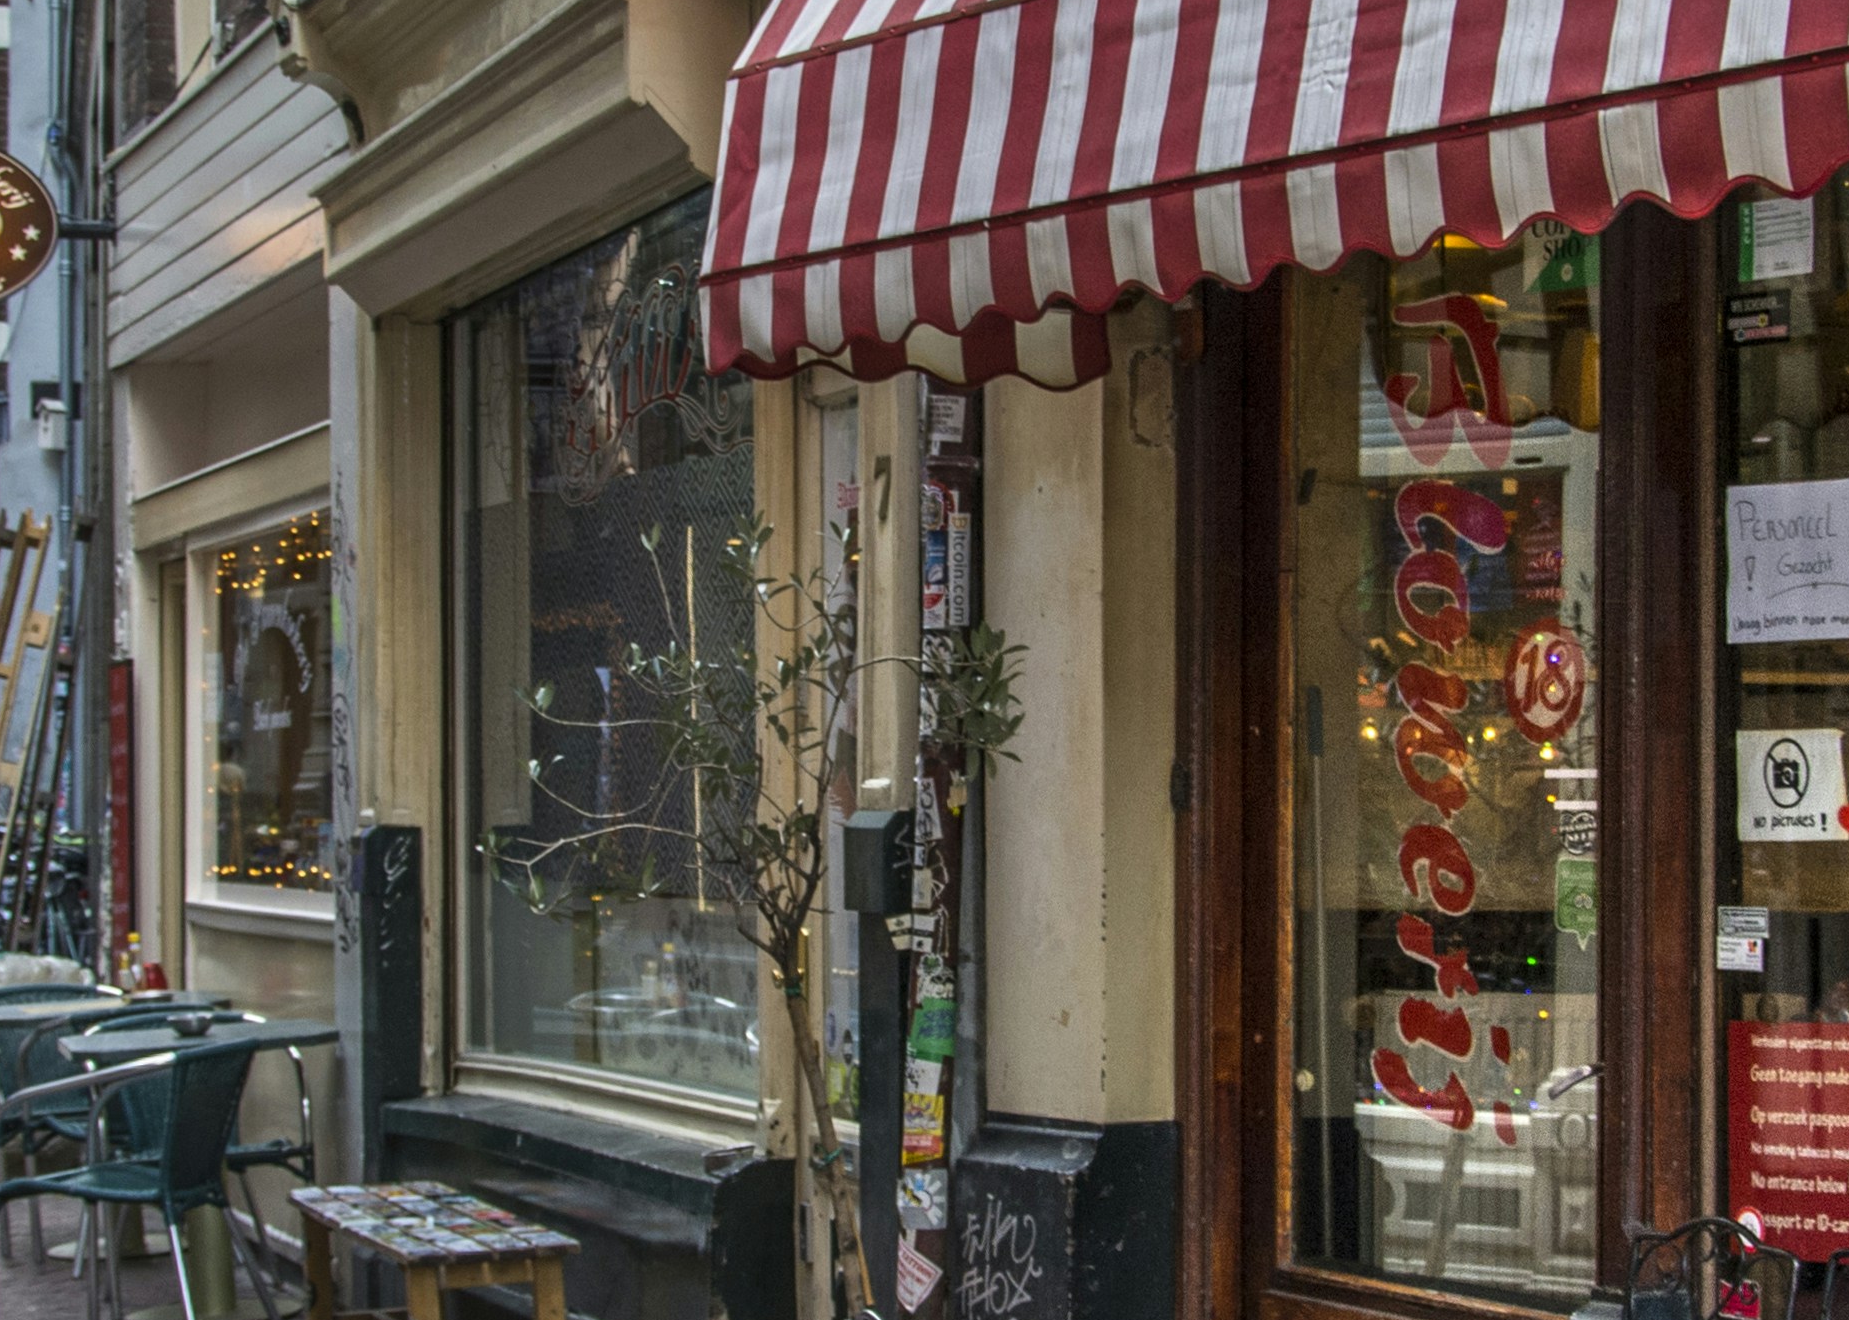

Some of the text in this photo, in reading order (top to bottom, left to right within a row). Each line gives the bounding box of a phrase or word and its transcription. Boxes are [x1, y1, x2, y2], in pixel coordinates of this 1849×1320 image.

[874, 454, 892, 522] 7
[1518, 640, 1572, 715] 18
[1750, 1063, 1778, 1083] Geen
[1779, 1066, 1822, 1089] toegang
[1750, 1105, 1765, 1129] Op
[1768, 1107, 1807, 1126] verzoek
[1751, 1171, 1765, 1190] No
[1766, 1173, 1815, 1192] entrance
[1816, 1174, 1847, 1194] below
[1764, 1214, 1802, 1235] ssport
[1803, 1217, 1816, 1231] or
